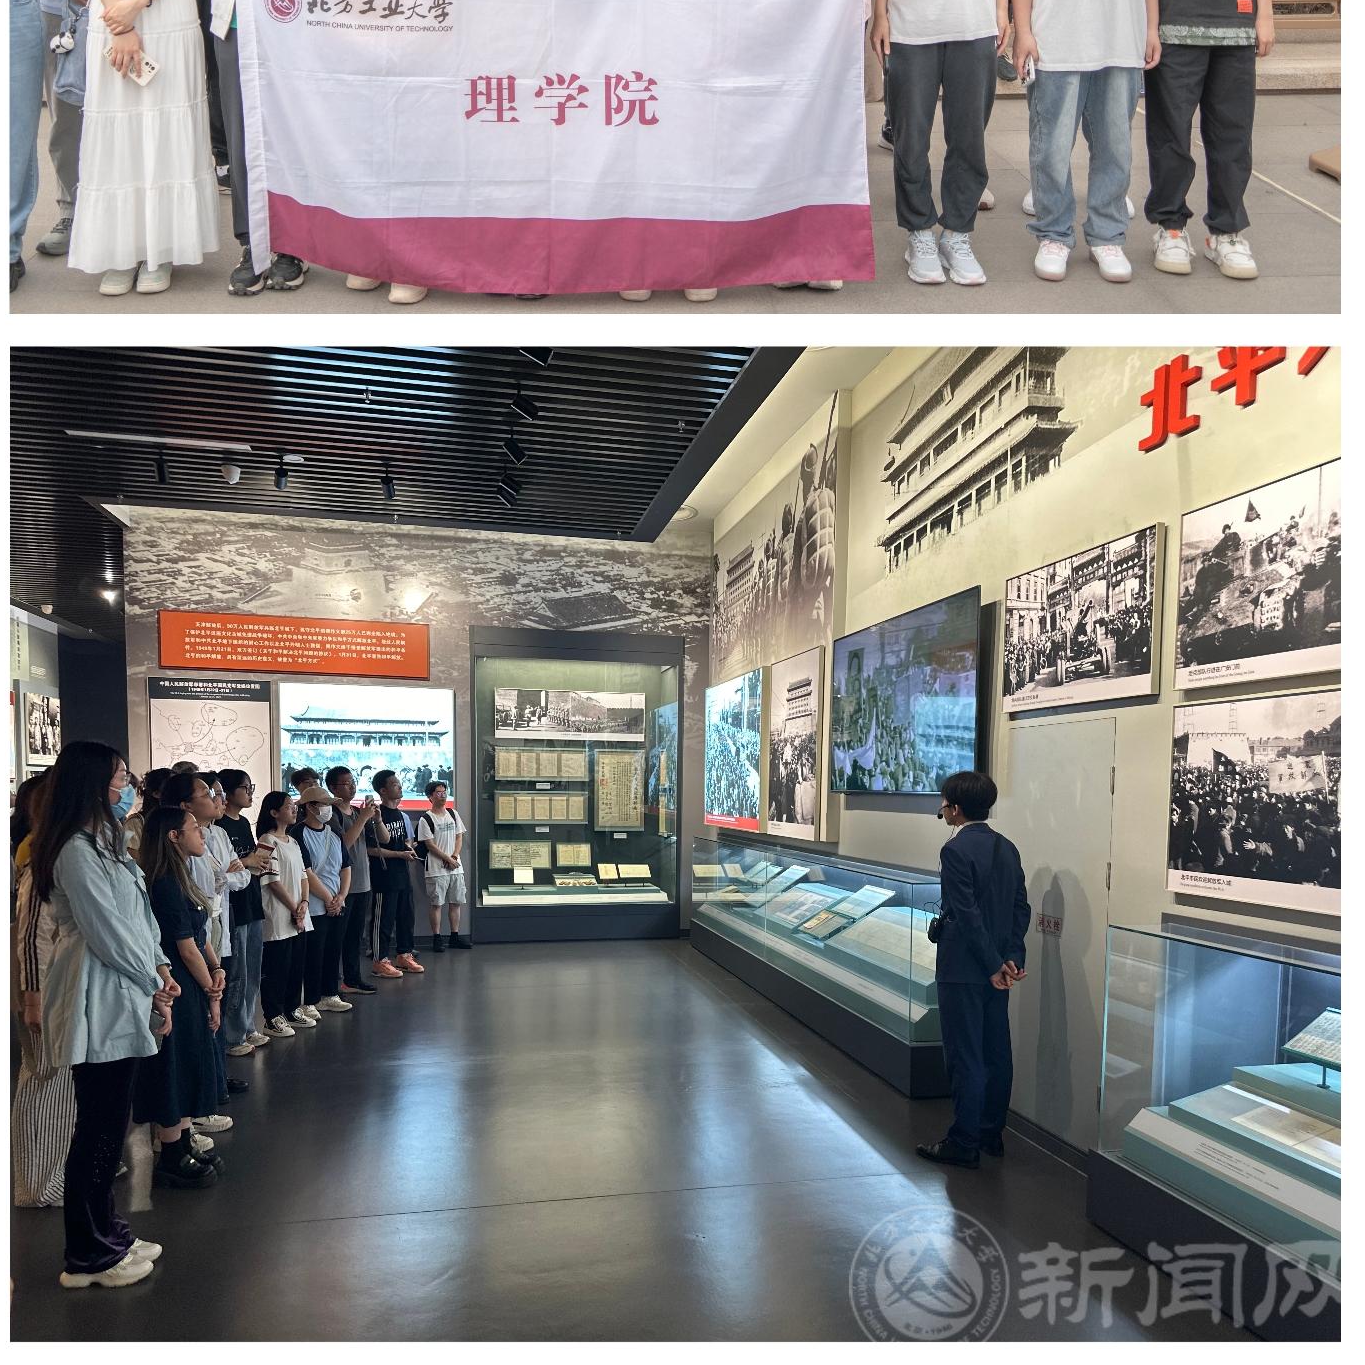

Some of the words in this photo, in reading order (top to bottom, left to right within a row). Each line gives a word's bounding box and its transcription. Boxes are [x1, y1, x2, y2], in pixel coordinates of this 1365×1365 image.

[306, 19, 331, 27] NORTH
[331, 21, 353, 29] CHINA
[354, 24, 394, 32] UNIVERSITY
[406, 25, 454, 33] TECHNOLOGY
[463, 70, 661, 128] 理学院
